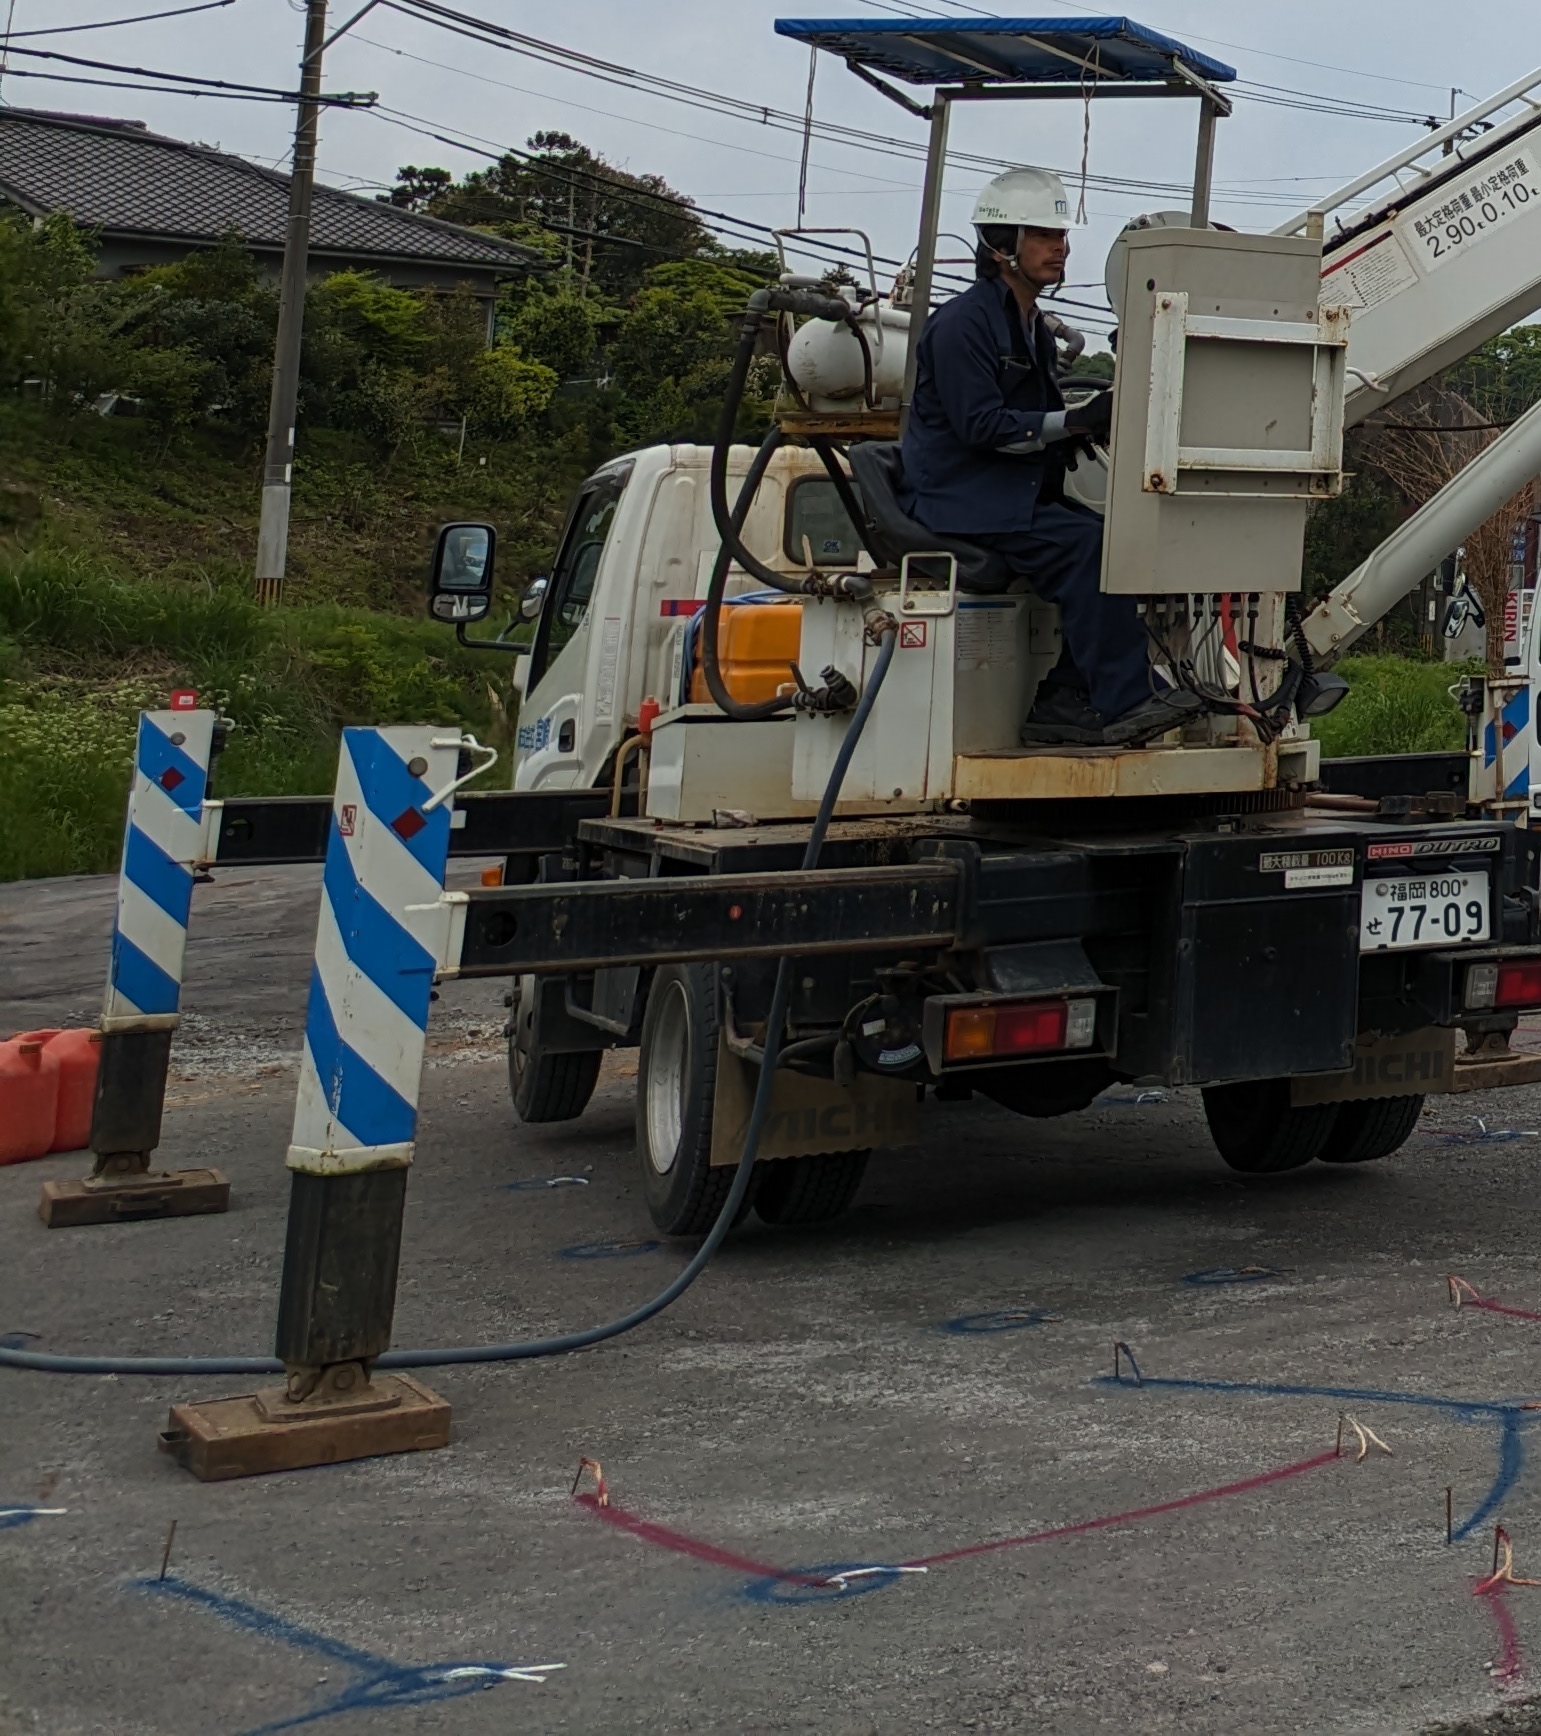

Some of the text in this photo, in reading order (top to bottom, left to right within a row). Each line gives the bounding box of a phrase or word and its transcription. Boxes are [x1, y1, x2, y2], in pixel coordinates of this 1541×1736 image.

[1413, 157, 1530, 239] 最大定格荷重 最小定格荷重
[1504, 592, 1518, 642] KIRIN
[1370, 838, 1499, 857] HINO DUTRO
[1389, 878, 1461, 902] 福岡 800
[1366, 899, 1483, 943] せ 77-09
